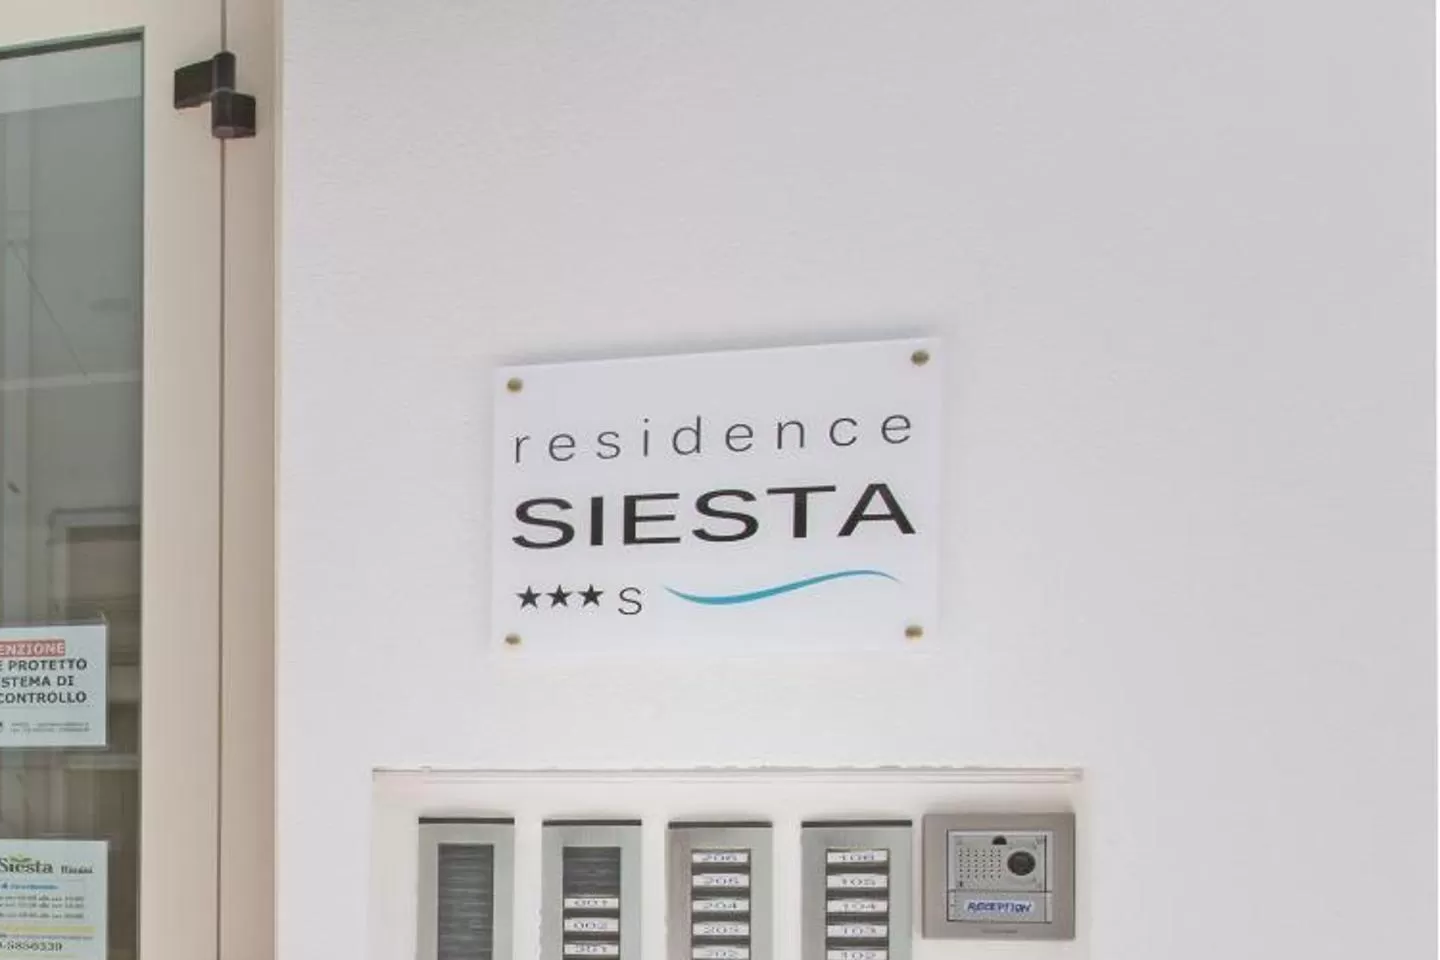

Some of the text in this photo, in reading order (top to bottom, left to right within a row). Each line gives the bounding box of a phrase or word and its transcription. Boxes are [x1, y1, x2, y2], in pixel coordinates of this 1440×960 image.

[514, 414, 912, 463] residence
[512, 483, 917, 549] SIESTA
[9, 658, 87, 671] PROTETTO
[57, 675, 74, 686] DI
[967, 902, 1032, 913] RECEPTION
